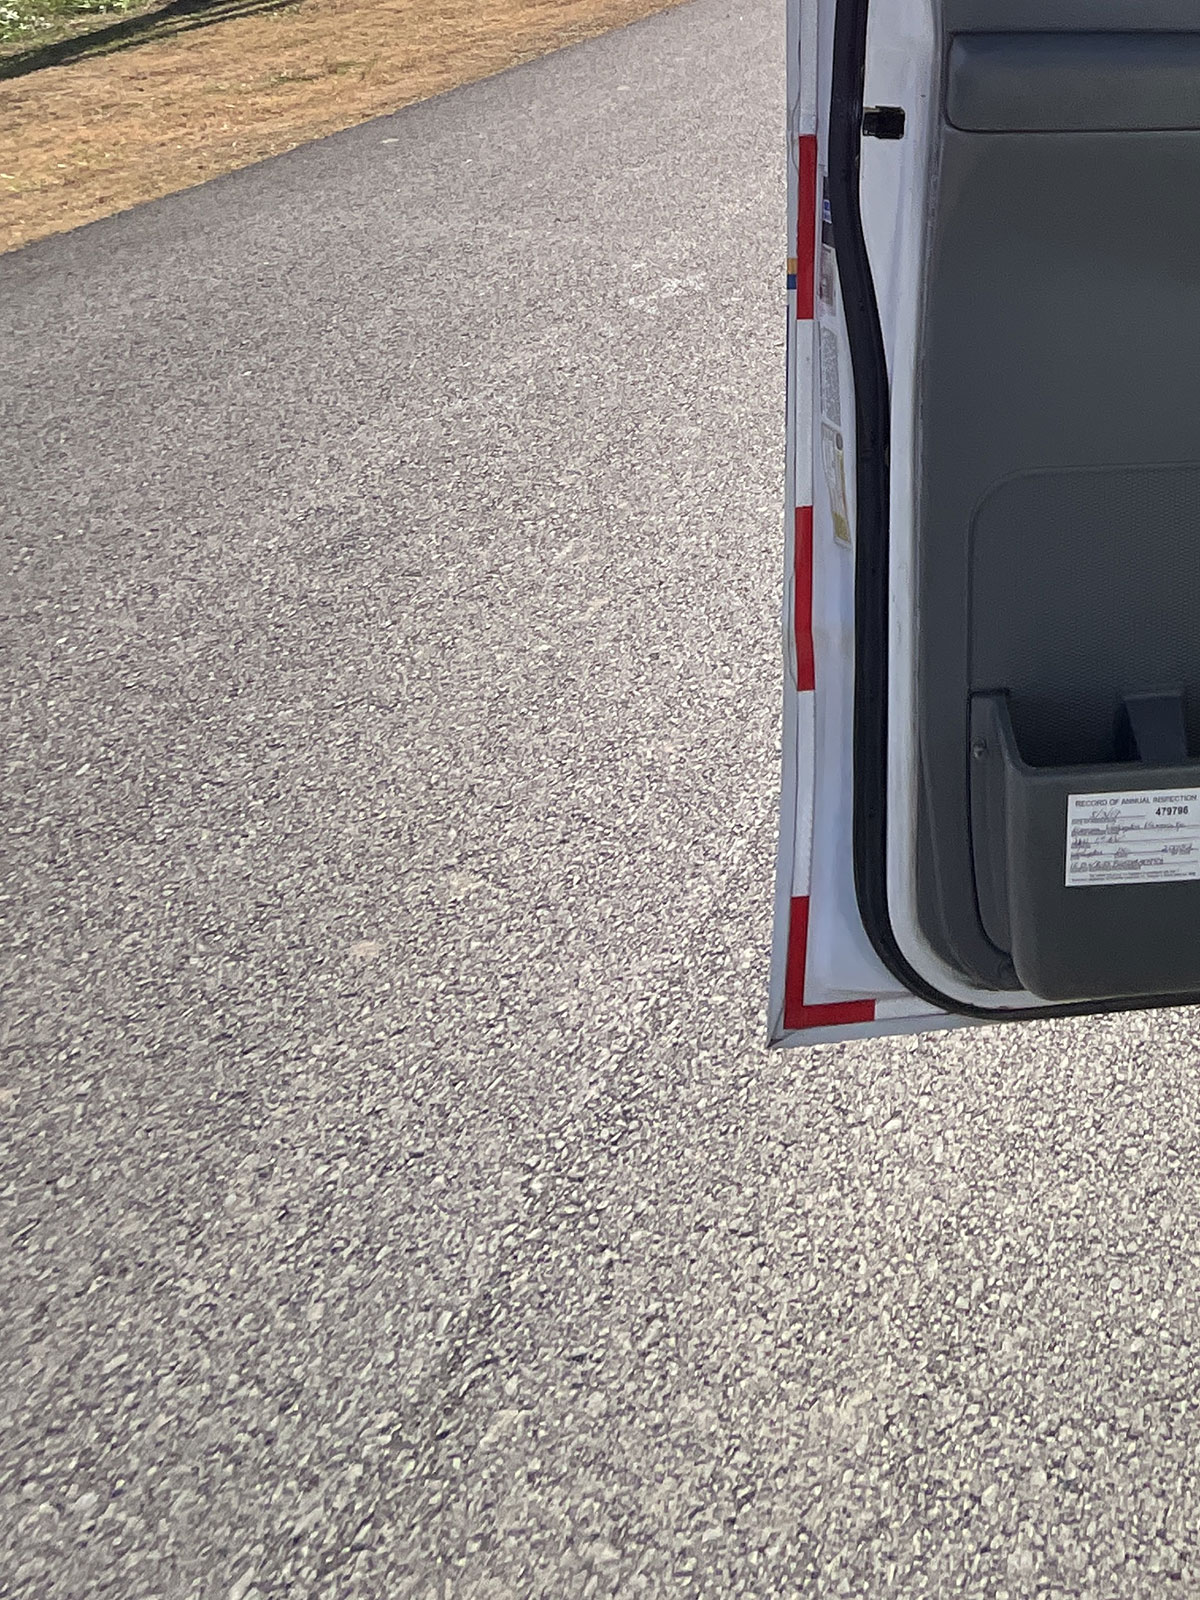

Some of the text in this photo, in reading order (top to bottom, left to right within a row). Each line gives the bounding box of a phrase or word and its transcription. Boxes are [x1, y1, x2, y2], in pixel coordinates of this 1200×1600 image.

[1075, 794, 1198, 807] RECORD OF ANNUAL INSPECTION
